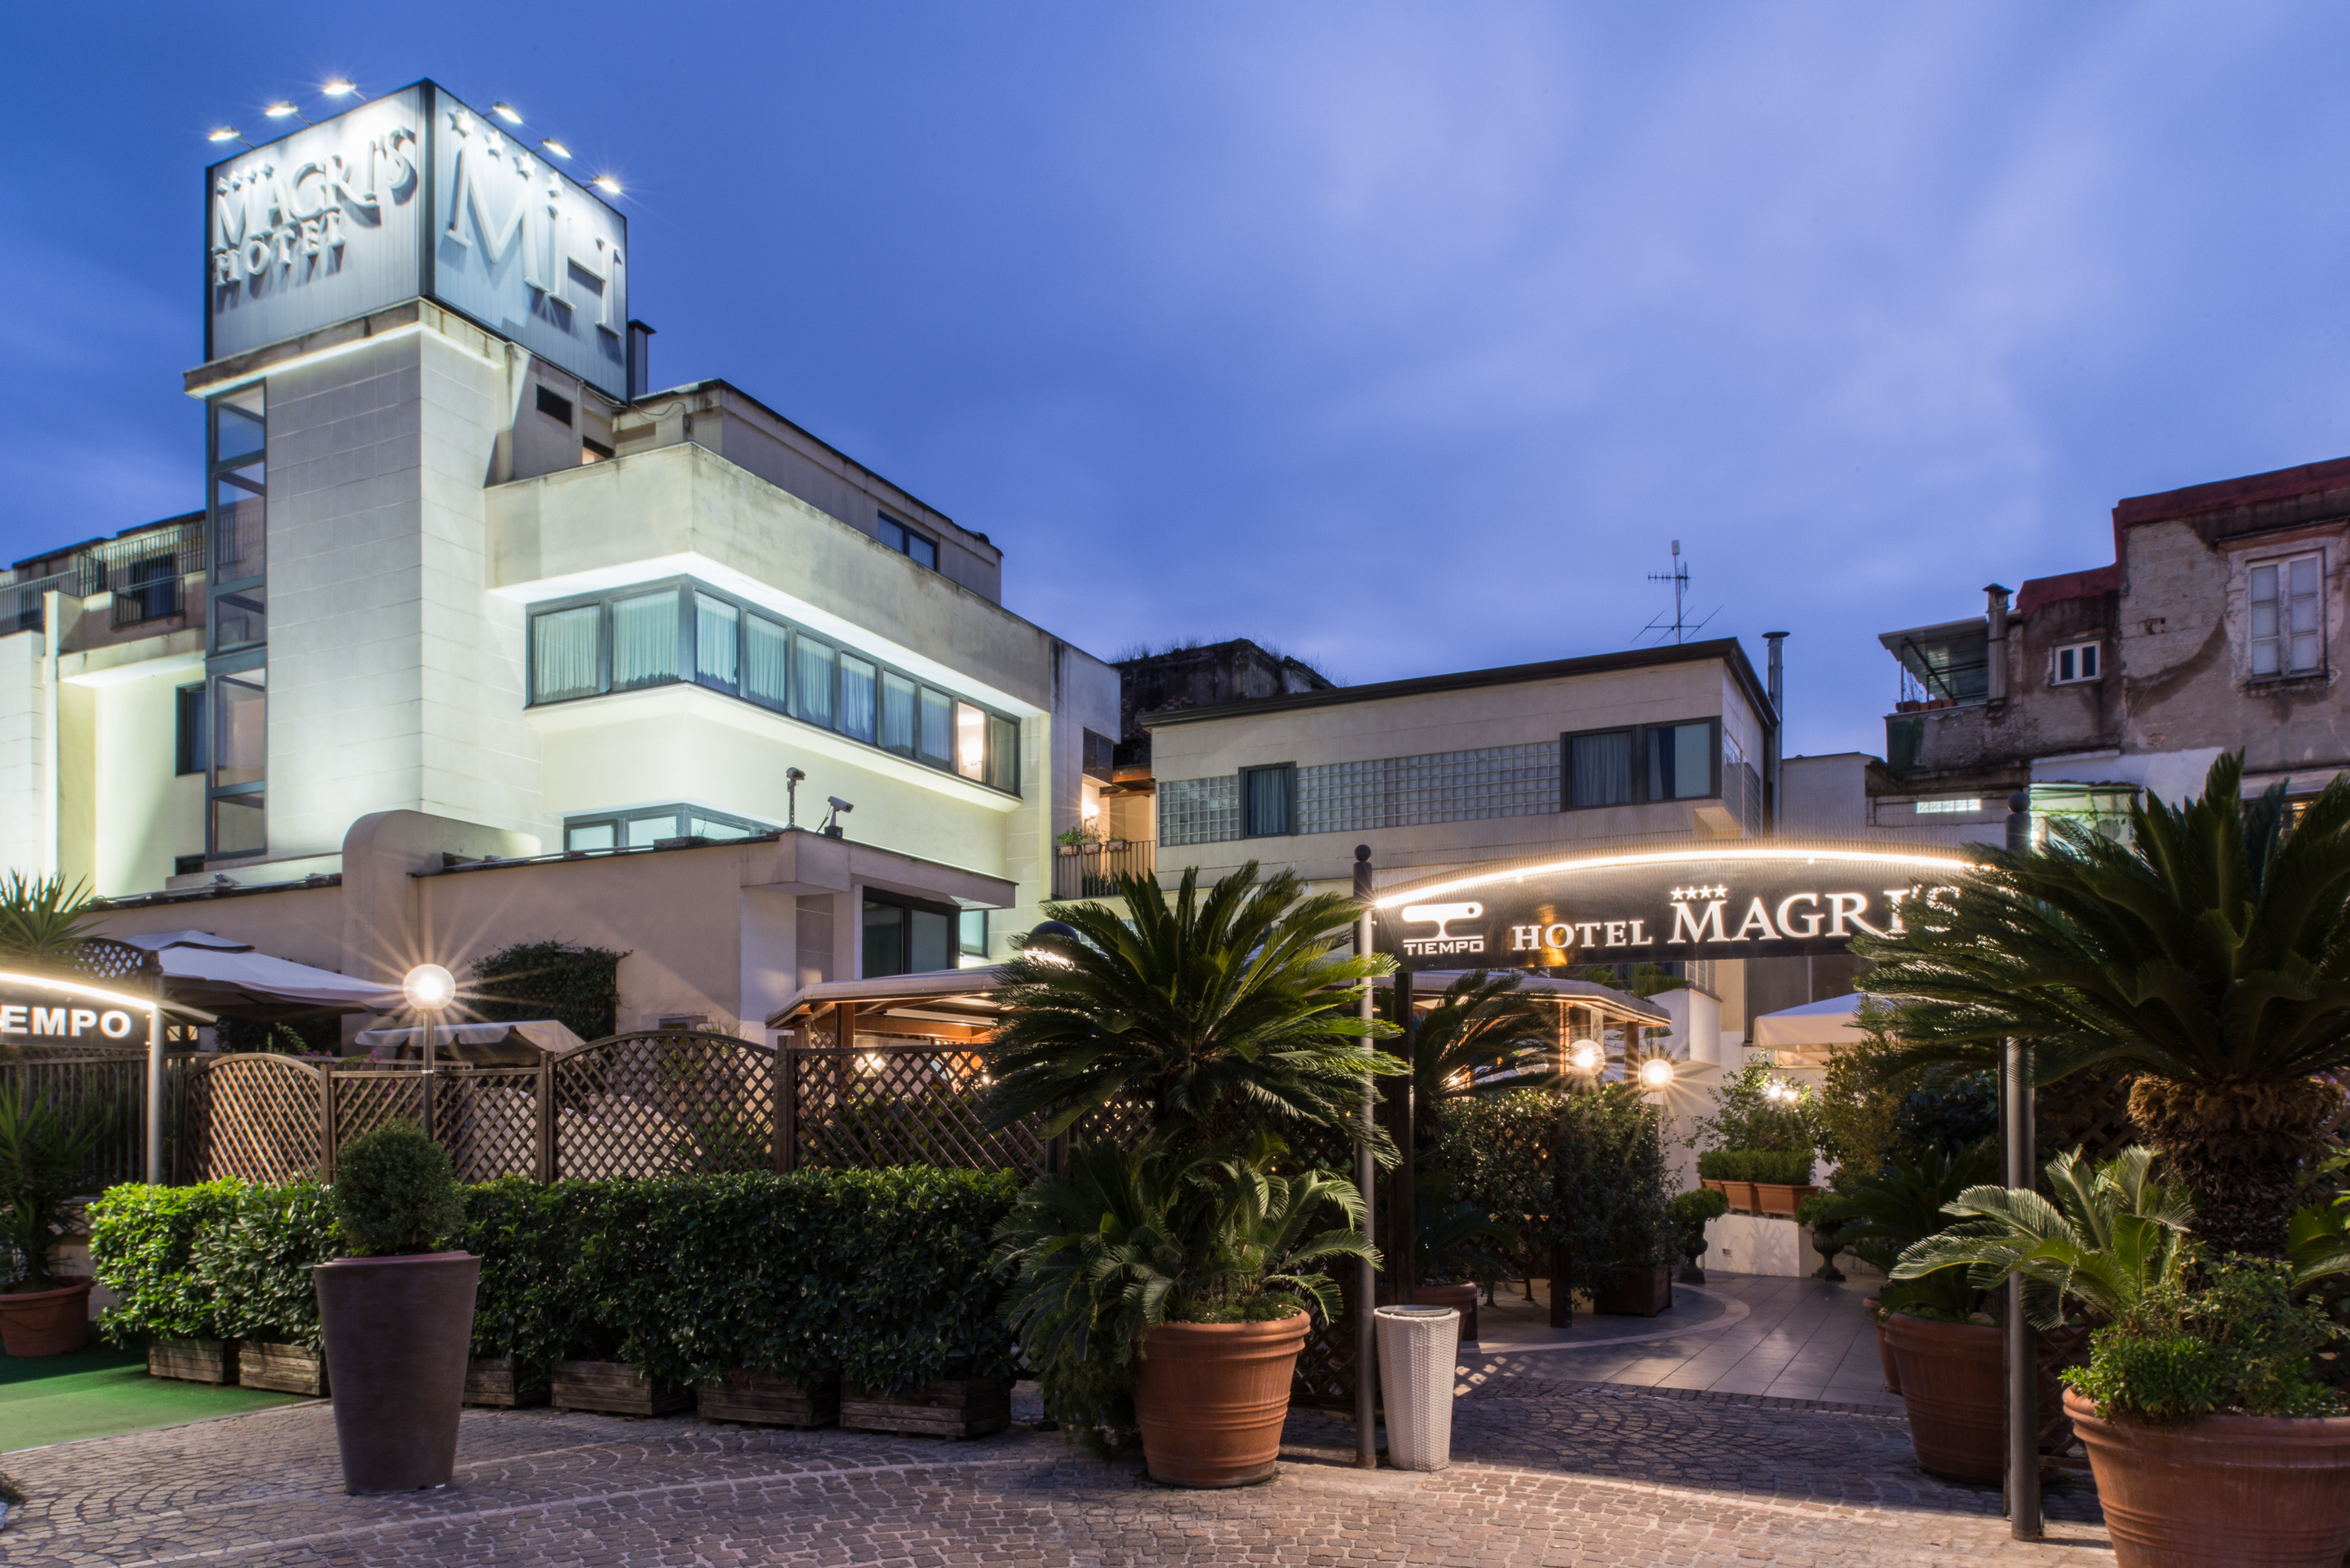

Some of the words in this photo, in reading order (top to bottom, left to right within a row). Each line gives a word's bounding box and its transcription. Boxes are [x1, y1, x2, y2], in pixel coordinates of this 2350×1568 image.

[212, 126, 417, 252] MAGRI'S
[213, 211, 345, 286] HOTEL
[445, 142, 622, 338] MH
[1403, 941, 1484, 956] TIEMPO
[1512, 920, 1653, 951] HOTEL
[0, 1004, 132, 1038] EMPO
